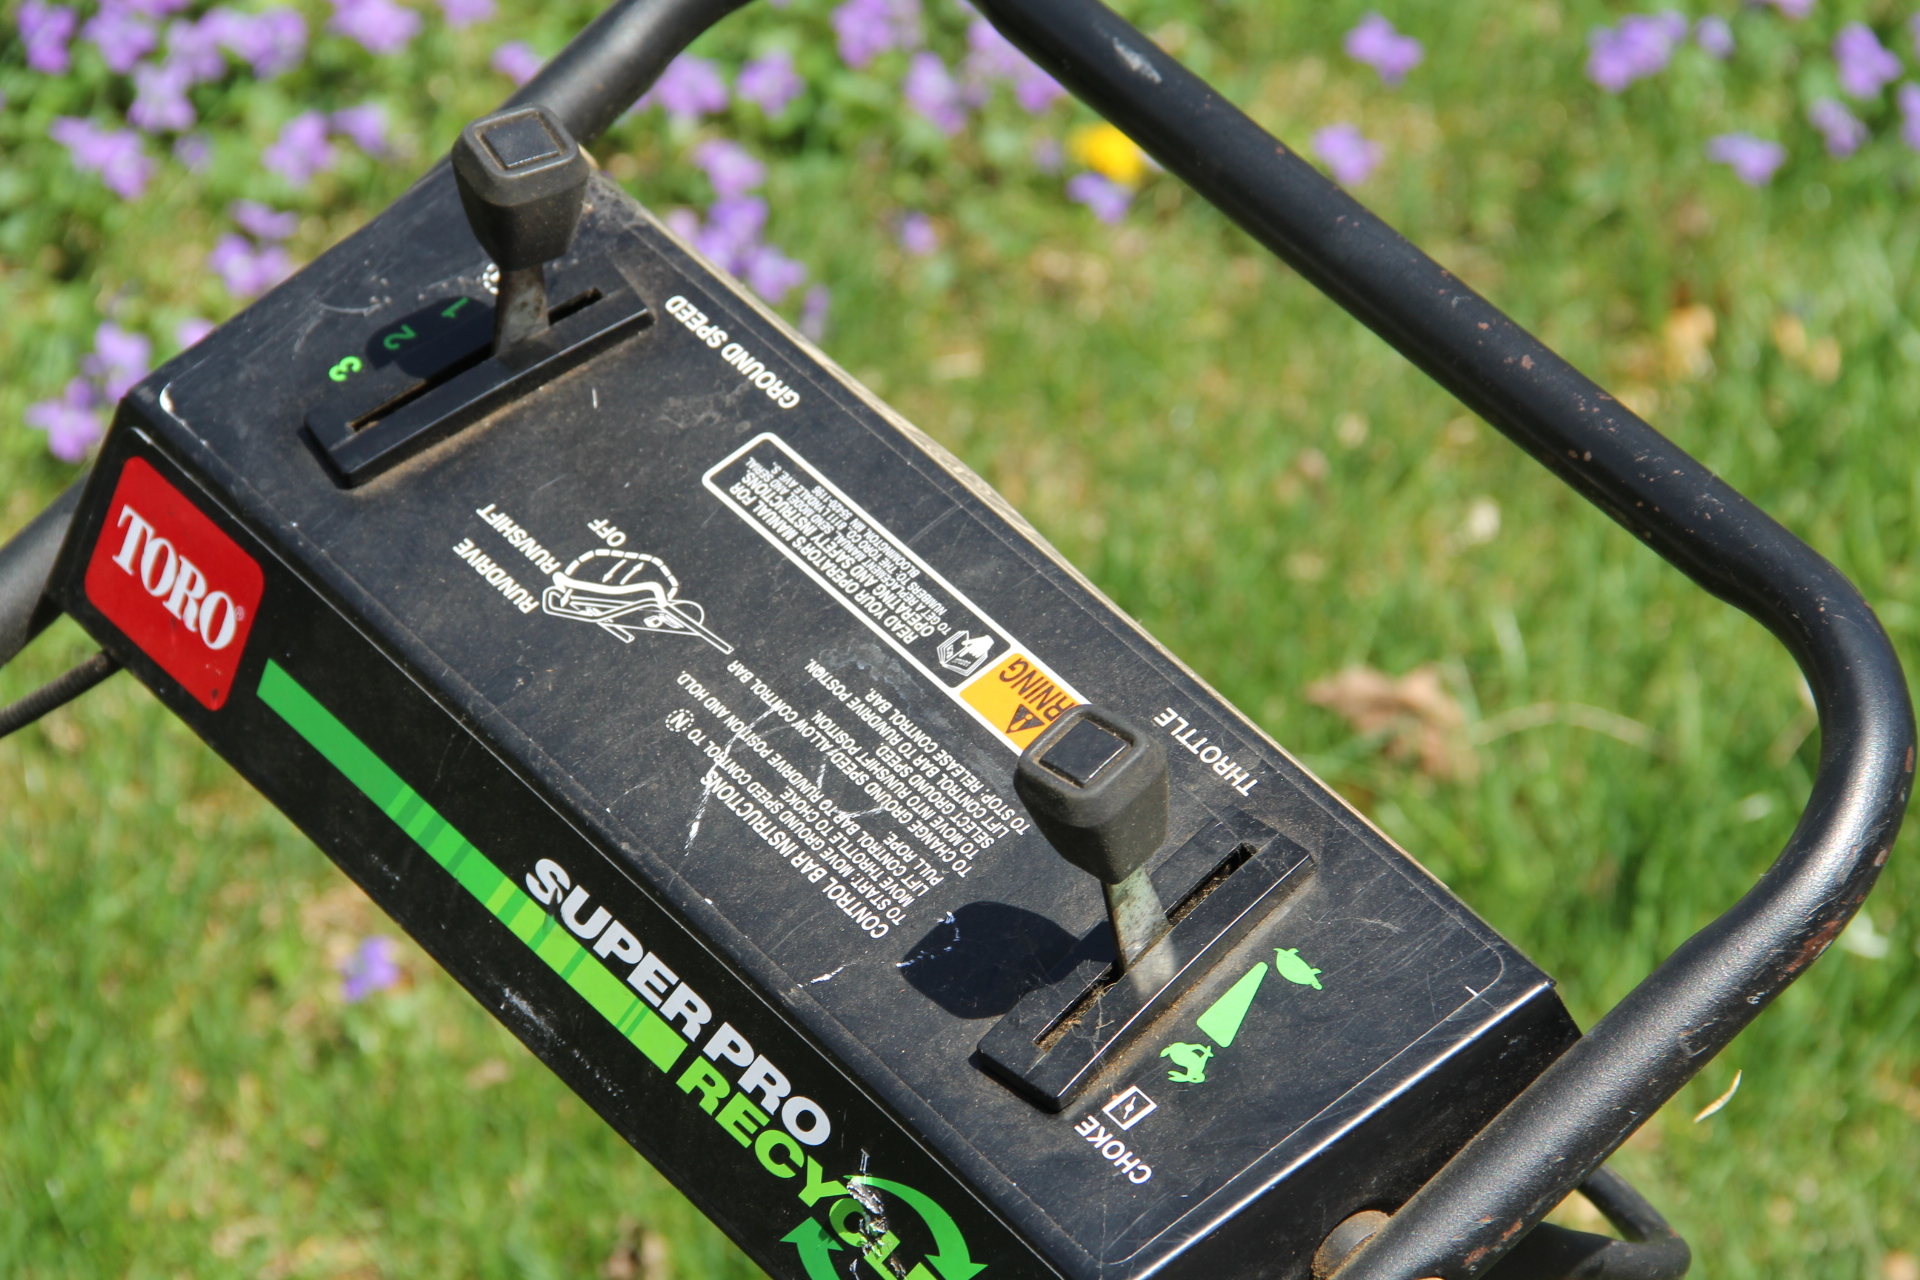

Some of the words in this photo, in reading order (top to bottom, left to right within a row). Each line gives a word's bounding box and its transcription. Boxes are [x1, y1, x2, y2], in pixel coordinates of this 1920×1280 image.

[441, 297, 469, 318] 1
[665, 295, 728, 348] SPEED
[383, 324, 417, 350] 2
[328, 355, 362, 382] 3
[721, 342, 800, 409] GROUND
[745, 456, 775, 483] SERIAL
[729, 481, 758, 506] FOR
[741, 468, 820, 537] INSTRUCTIONS.
[767, 477, 790, 497] AND
[793, 484, 834, 517] LYNDALE
[811, 485, 853, 521] 55420-1196
[752, 499, 799, 541] MANUAL
[782, 490, 817, 518] MODEL
[587, 518, 626, 547] OFF
[809, 512, 835, 534] SEND
[826, 511, 851, 531] 8111
[849, 517, 867, 533] MN
[476, 503, 561, 575] RUN/SHIFT
[810, 530, 858, 569] SAFETY
[857, 537, 886, 562] TORO
[452, 538, 539, 614] RUN/DRIVE
[791, 535, 860, 594] OPERATOR'S
[849, 563, 880, 587] AND
[878, 555, 901, 574] THE
[861, 556, 921, 607] REPLACEMENT
[854, 589, 888, 620] YOUR
[872, 582, 939, 637] OPERATING
[906, 581, 948, 616] NUMBERS
[915, 601, 927, 612] A
[883, 615, 919, 645] READ
[919, 607, 941, 627] GET
[936, 622, 952, 636] TO
[676, 670, 710, 701] HOLD.
[727, 659, 755, 684] BAR
[749, 678, 799, 722] CONTROL
[864, 687, 893, 714] BAR.
[999, 657, 1074, 722] RNING
[703, 697, 731, 718] AND
[845, 696, 904, 746] RUN/DRIVE
[687, 728, 707, 746] TO
[722, 714, 774, 759] POSITION
[790, 718, 834, 752] ALLOW
[810, 709, 863, 756] POSITION.
[888, 708, 939, 753] CONTROL
[703, 740, 752, 785] CONTROL
[872, 742, 914, 778] SPEED.
[897, 742, 917, 760] TO
[912, 754, 941, 778] BAR
[1153, 707, 1258, 797] THROTTLE
[766, 753, 825, 803] RUN/DRIVE
[854, 752, 913, 800] RUN/SHIFT
[931, 749, 984, 793] RELEASE
[746, 782, 785, 814] SPEED
[779, 785, 820, 823] CHOKE.
[818, 799, 841, 817] TO
[864, 782, 914, 824] GROUND
[906, 795, 937, 821] INTO
[908, 774, 956, 815] GROUND
[936, 773, 987, 819] CONTROL
[979, 788, 1016, 821] STOP:
[700, 767, 799, 857] INSTRUCTIONS
[814, 819, 834, 837] TO
[832, 810, 861, 836] BAR
[980, 816, 1010, 839] LIFT
[1009, 817, 1031, 836] TO
[778, 810, 826, 852] GROUND
[906, 819, 957, 862] CHANGE
[929, 815, 967, 847] MOVE
[947, 812, 995, 849] SELECT
[818, 846, 856, 878] MOVE
[828, 831, 885, 882] THROTTLE
[852, 830, 907, 878] CONTROL
[882, 831, 918, 863] ROPE.
[959, 842, 980, 860] TO
[790, 851, 828, 883] BAR
[913, 857, 944, 886] PULL
[951, 859, 973, 878] TO
[850, 873, 892, 910] START:
[878, 876, 915, 908] MOVE
[900, 874, 930, 897] LIFT
[822, 876, 889, 938] CONTROL
[885, 907, 906, 926] TO
[525, 858, 712, 1042] SUPER
[702, 1022, 831, 1146] PRO
[1074, 1115, 1152, 1184] CHOKE
[676, 1056, 938, 1280] RECYCL
